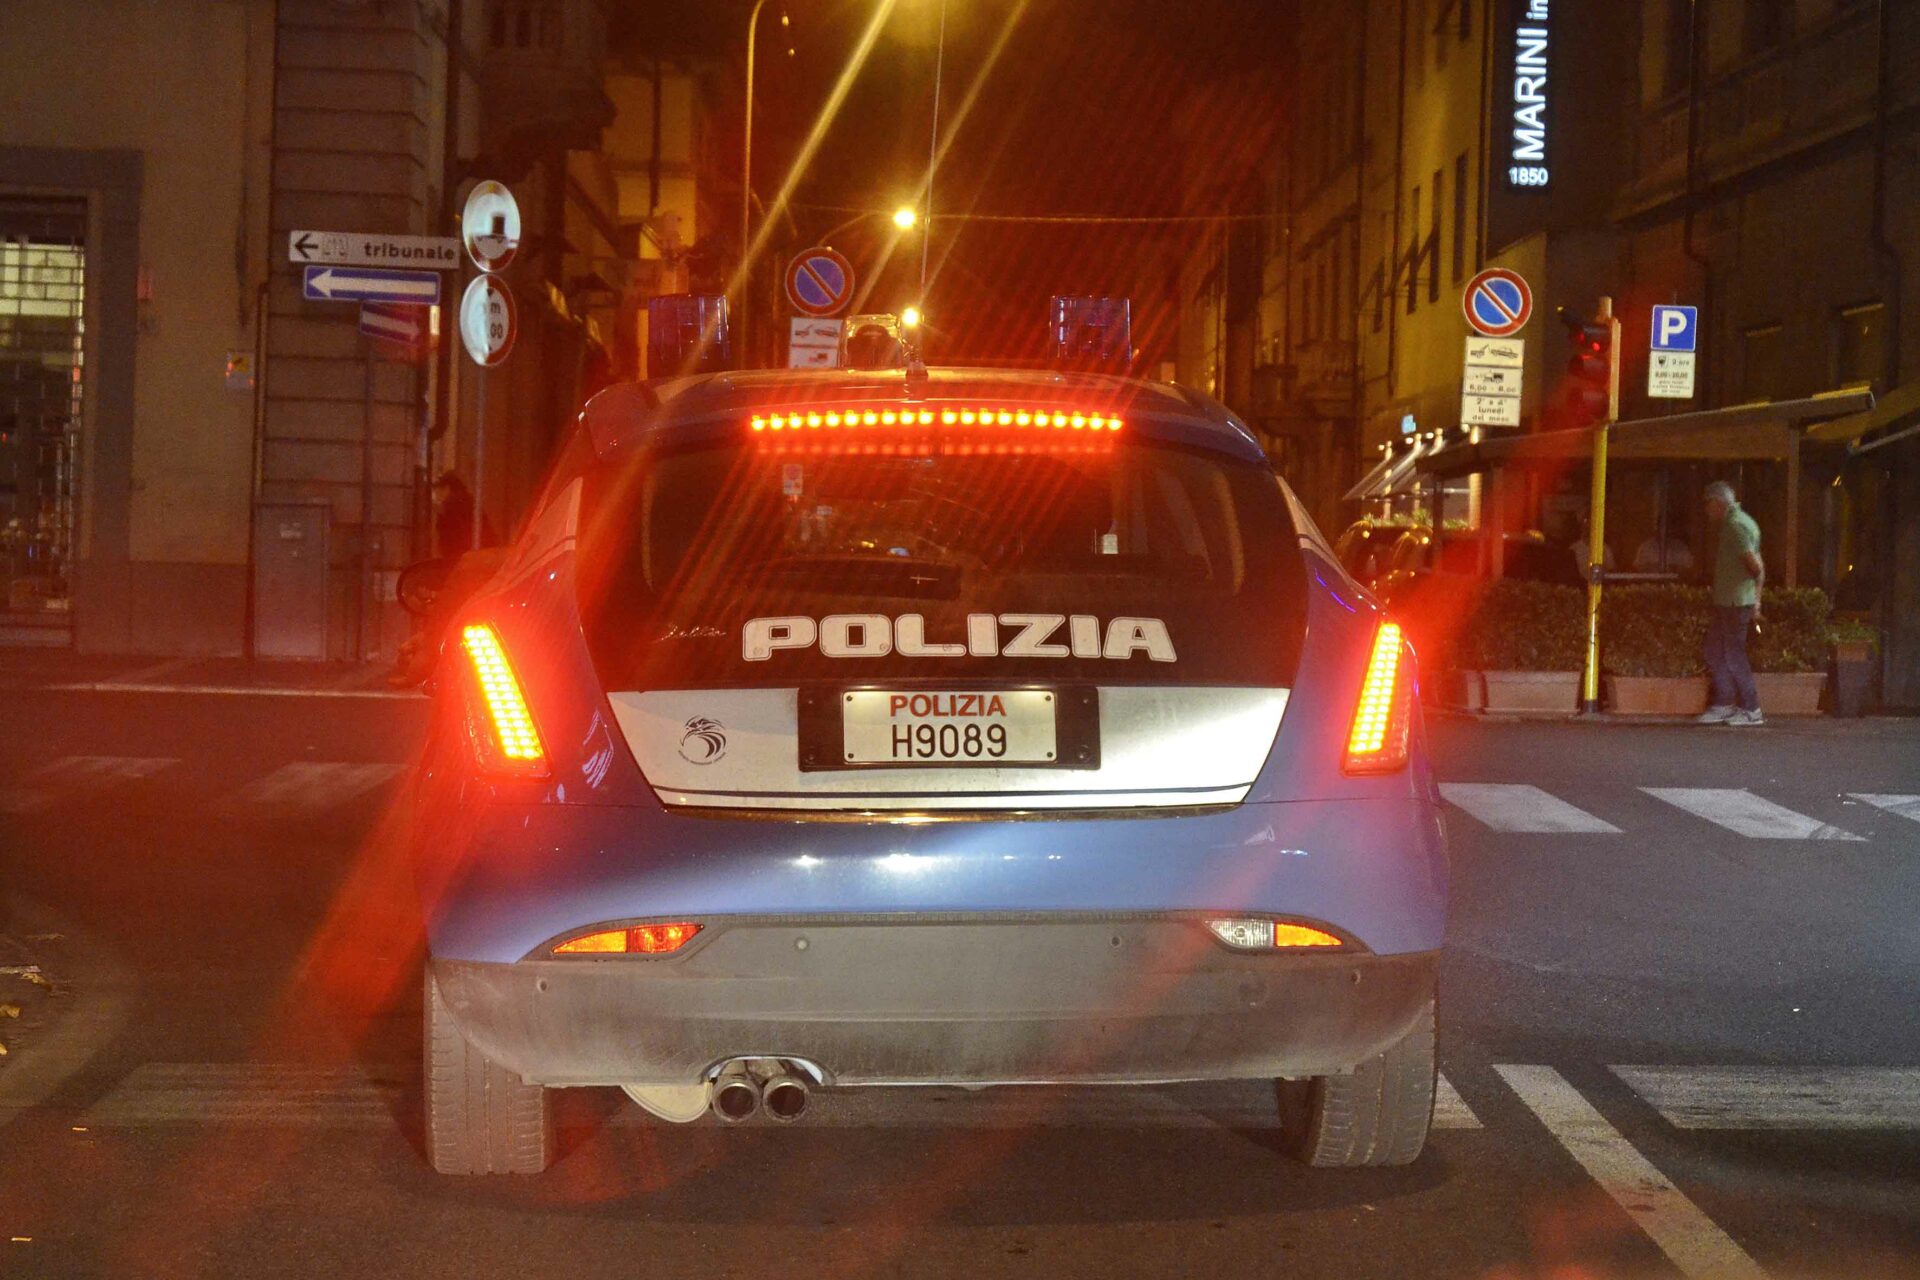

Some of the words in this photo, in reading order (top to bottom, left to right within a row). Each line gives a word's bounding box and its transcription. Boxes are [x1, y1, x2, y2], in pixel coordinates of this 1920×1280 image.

[1513, 28, 1548, 160] MARINI
[1509, 167, 1548, 186] 1850
[364, 241, 455, 260] tribunale
[1660, 310, 1687, 346] P
[743, 613, 1177, 662] POLIZIA
[889, 693, 1007, 718] POLIZIA
[891, 723, 1008, 758] H9089
